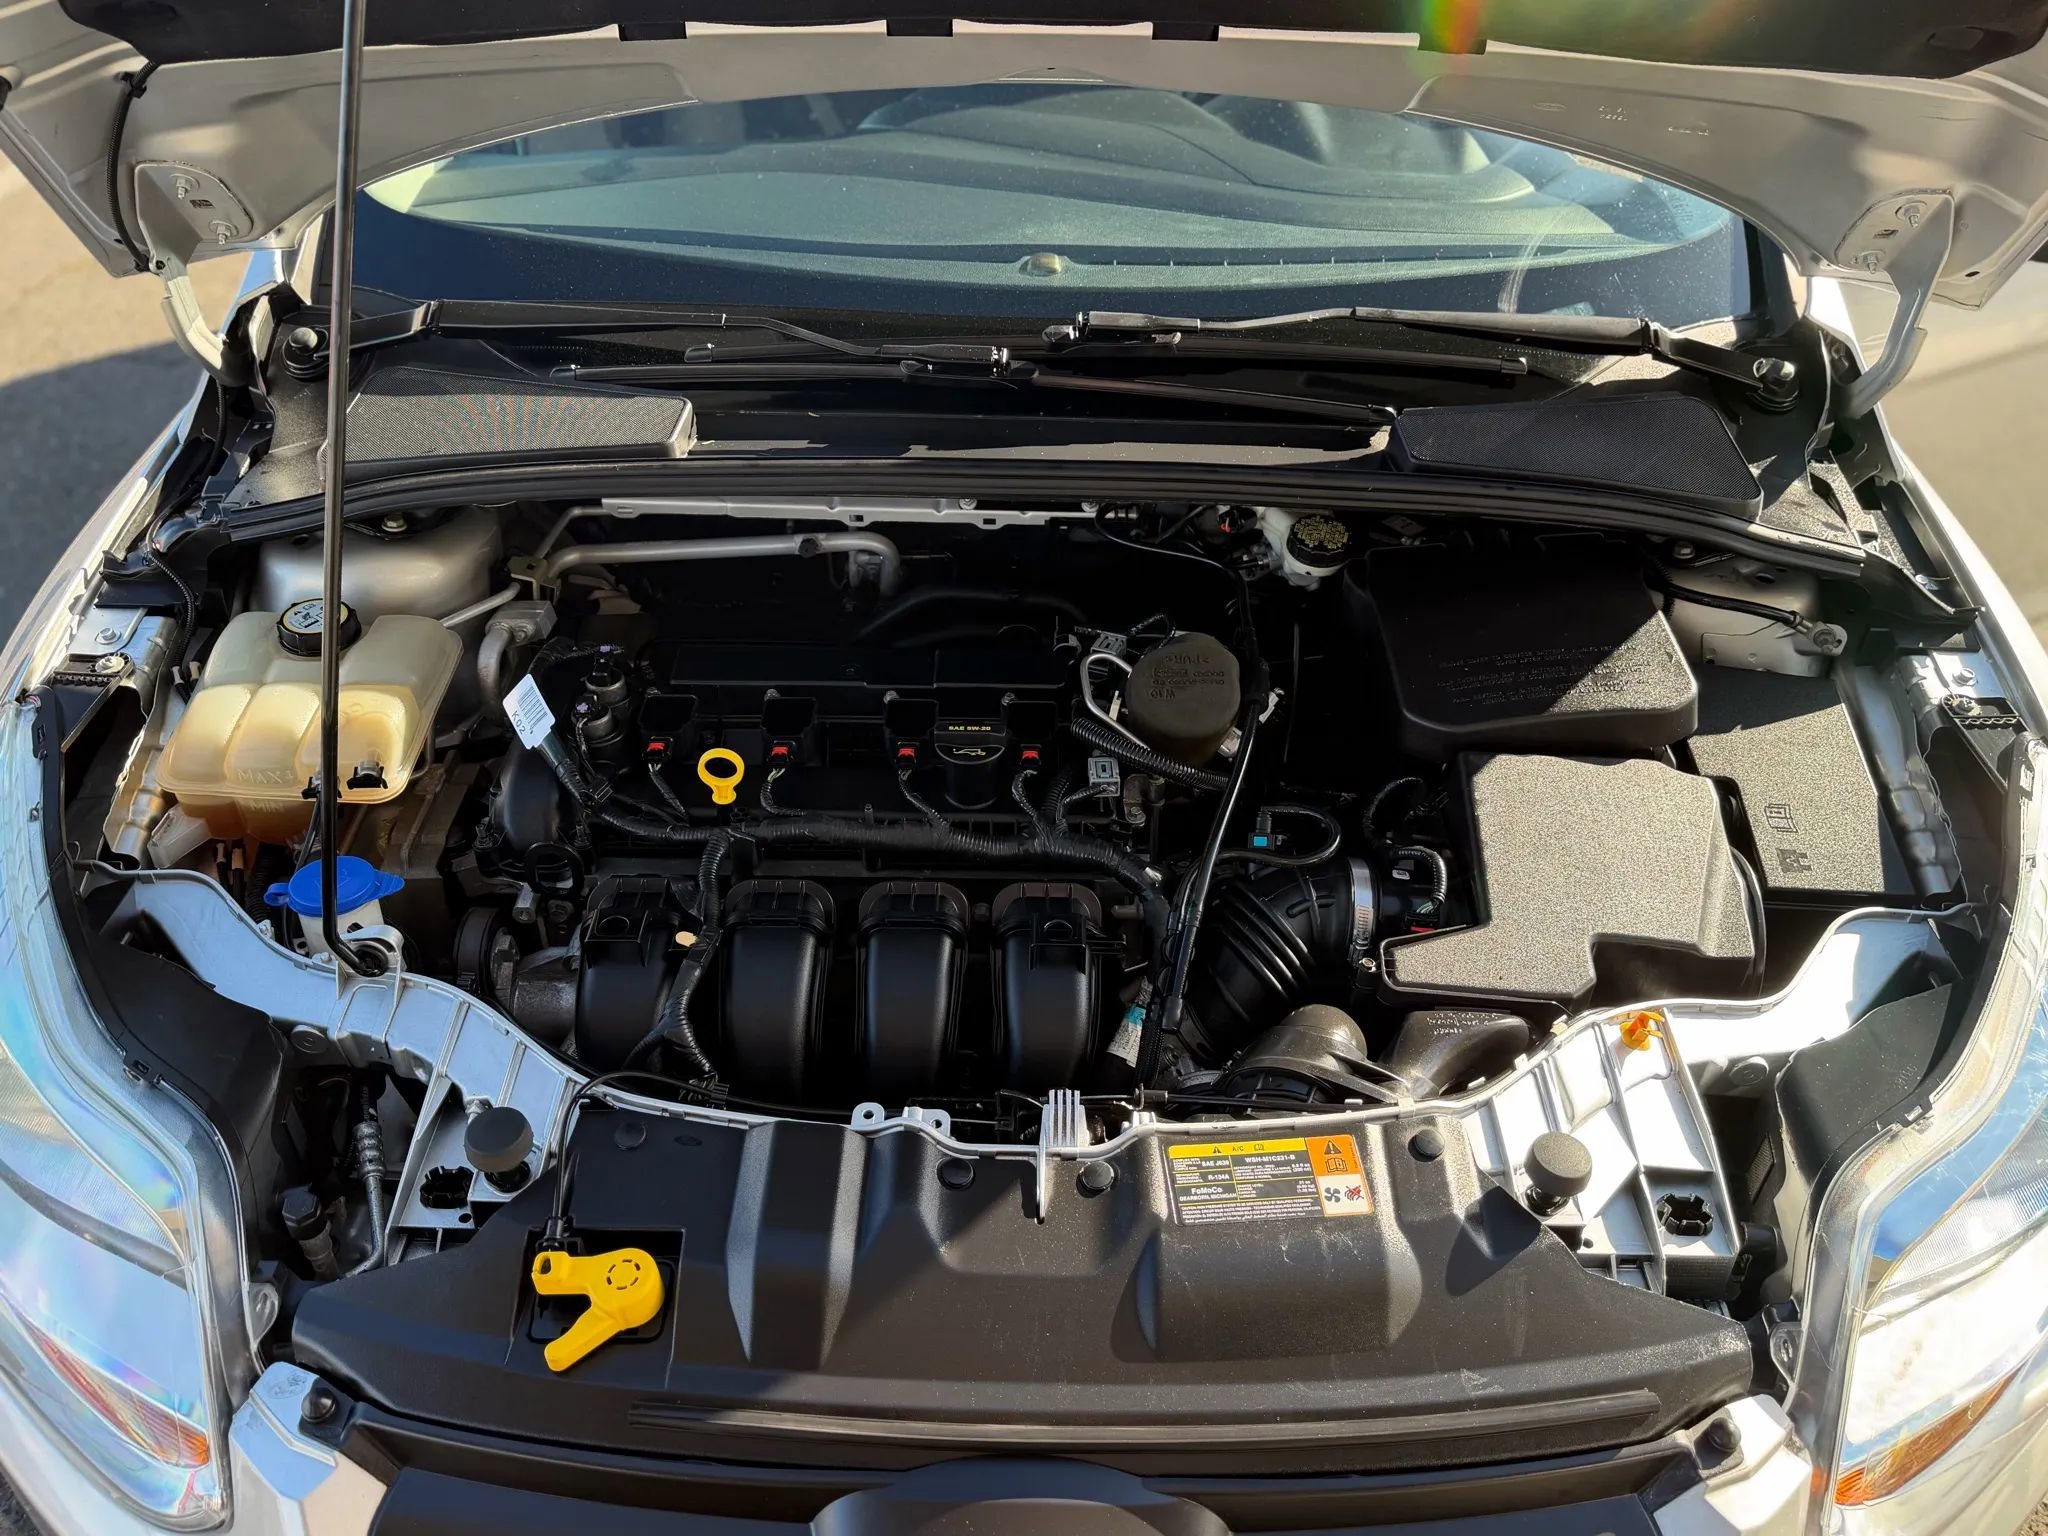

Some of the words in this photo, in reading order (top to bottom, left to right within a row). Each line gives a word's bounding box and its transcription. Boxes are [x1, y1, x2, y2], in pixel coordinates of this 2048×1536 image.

[237, 769, 283, 784] MAX
[1207, 1173, 1230, 1181] R-134A
[1191, 1186, 1223, 1195] FoMoCo
